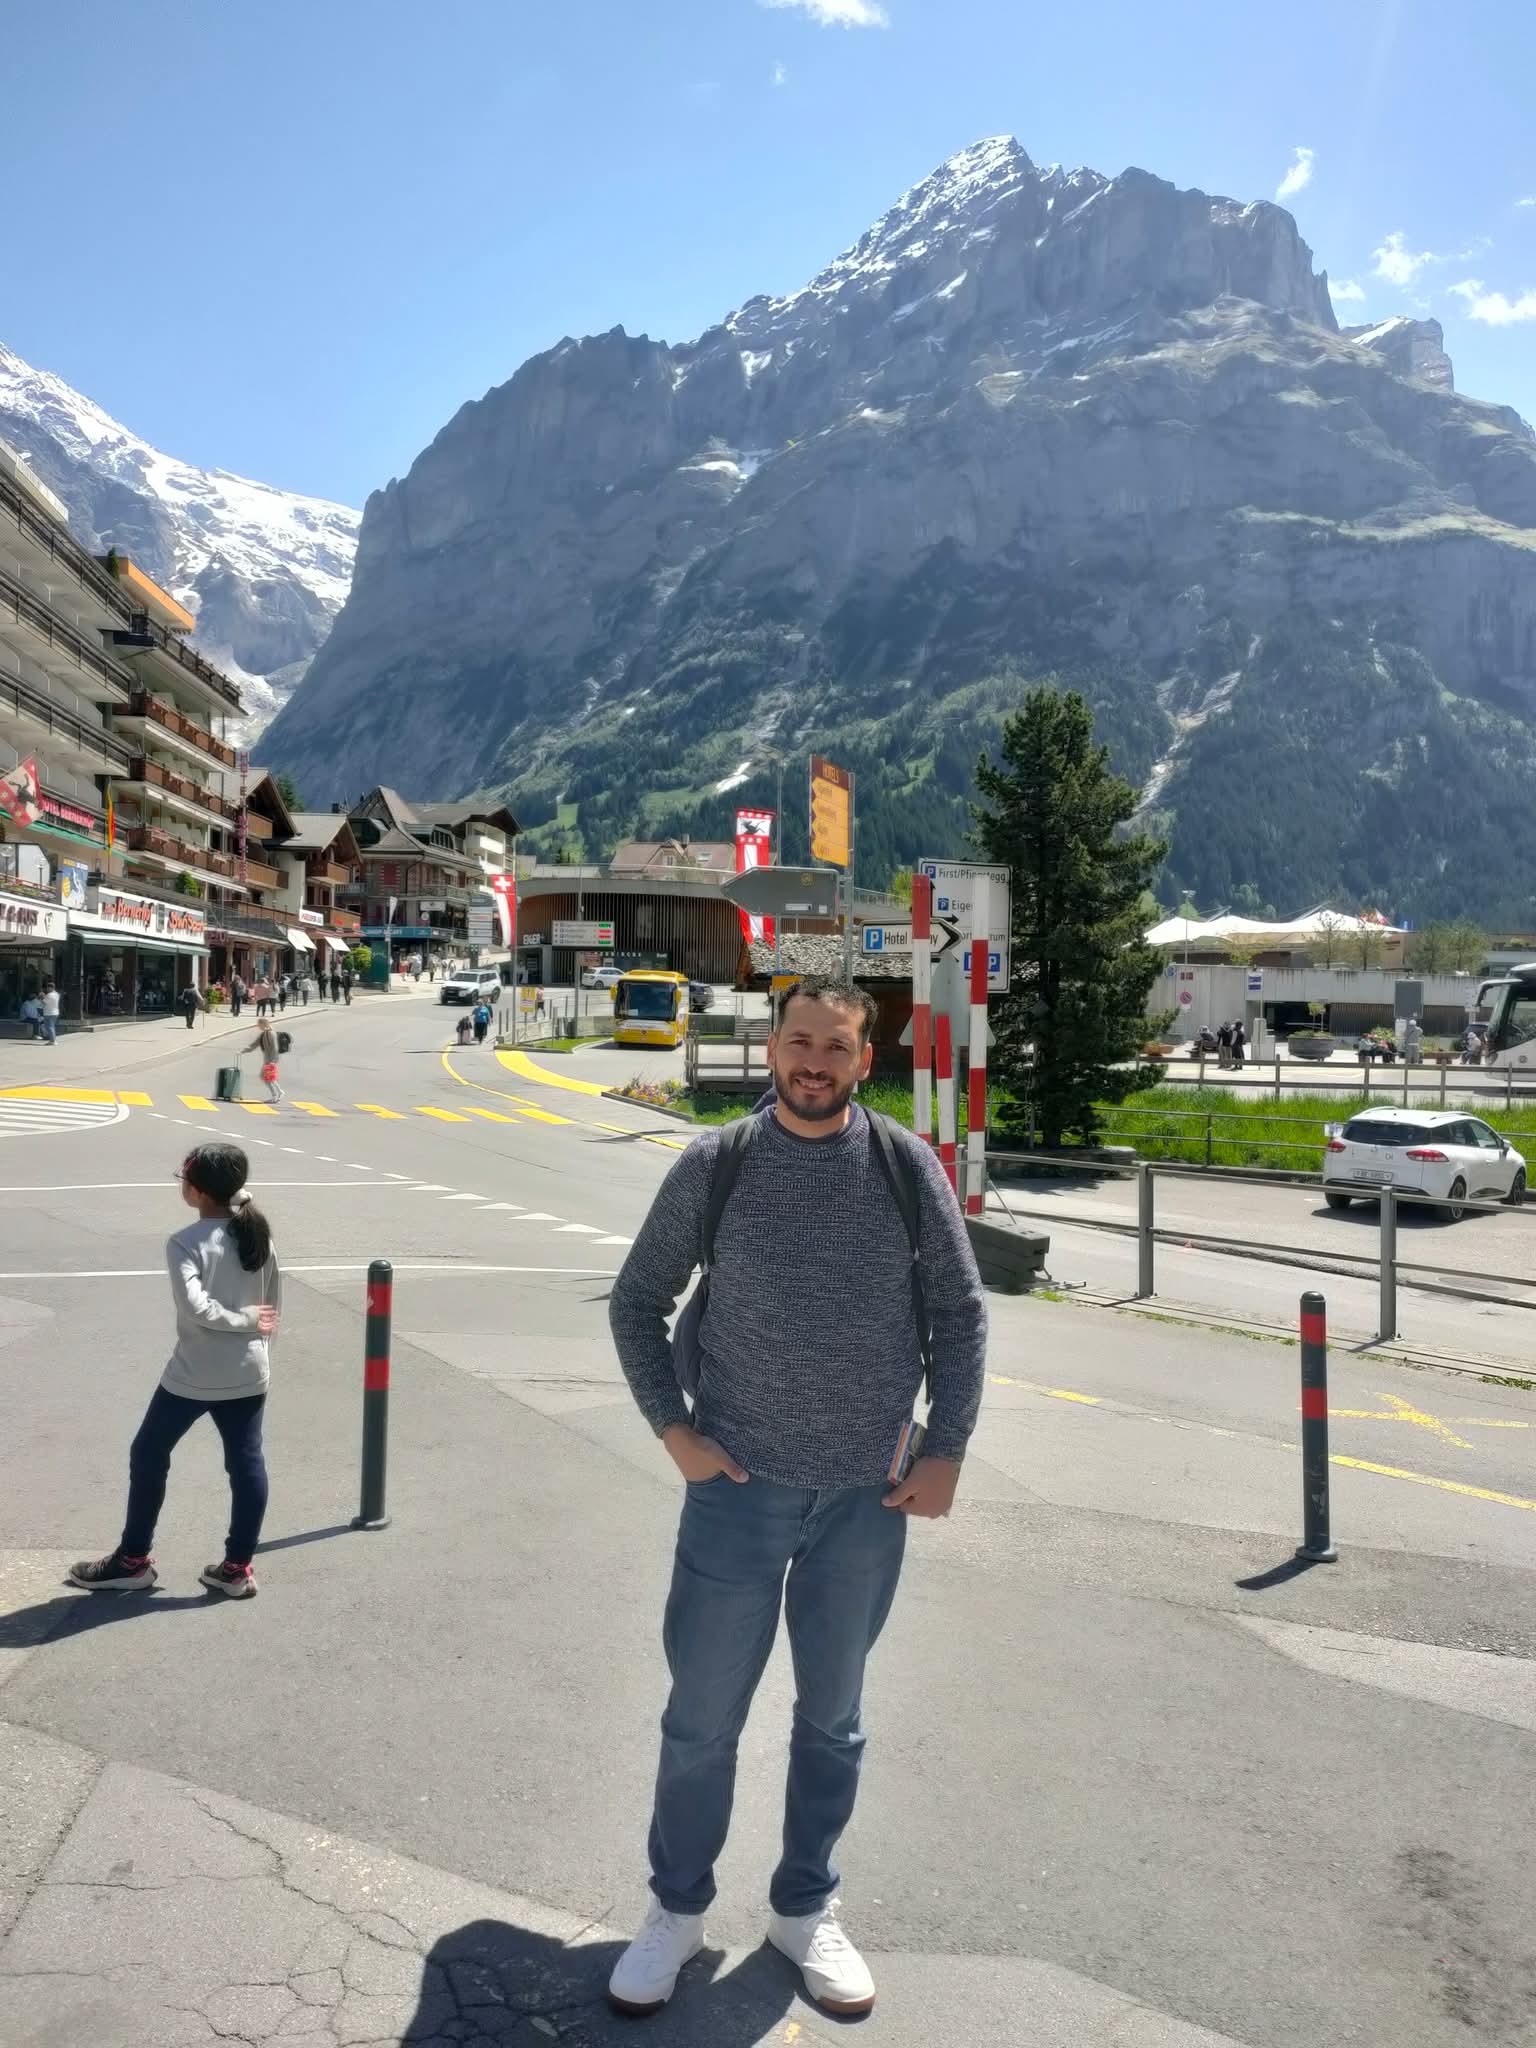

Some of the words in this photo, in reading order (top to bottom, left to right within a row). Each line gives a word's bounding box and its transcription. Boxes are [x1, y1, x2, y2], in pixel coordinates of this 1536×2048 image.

[823, 763, 839, 784] HOTELS
[938, 866, 1006, 883] First/Pfiegg
[885, 931, 907, 944] Hotel
